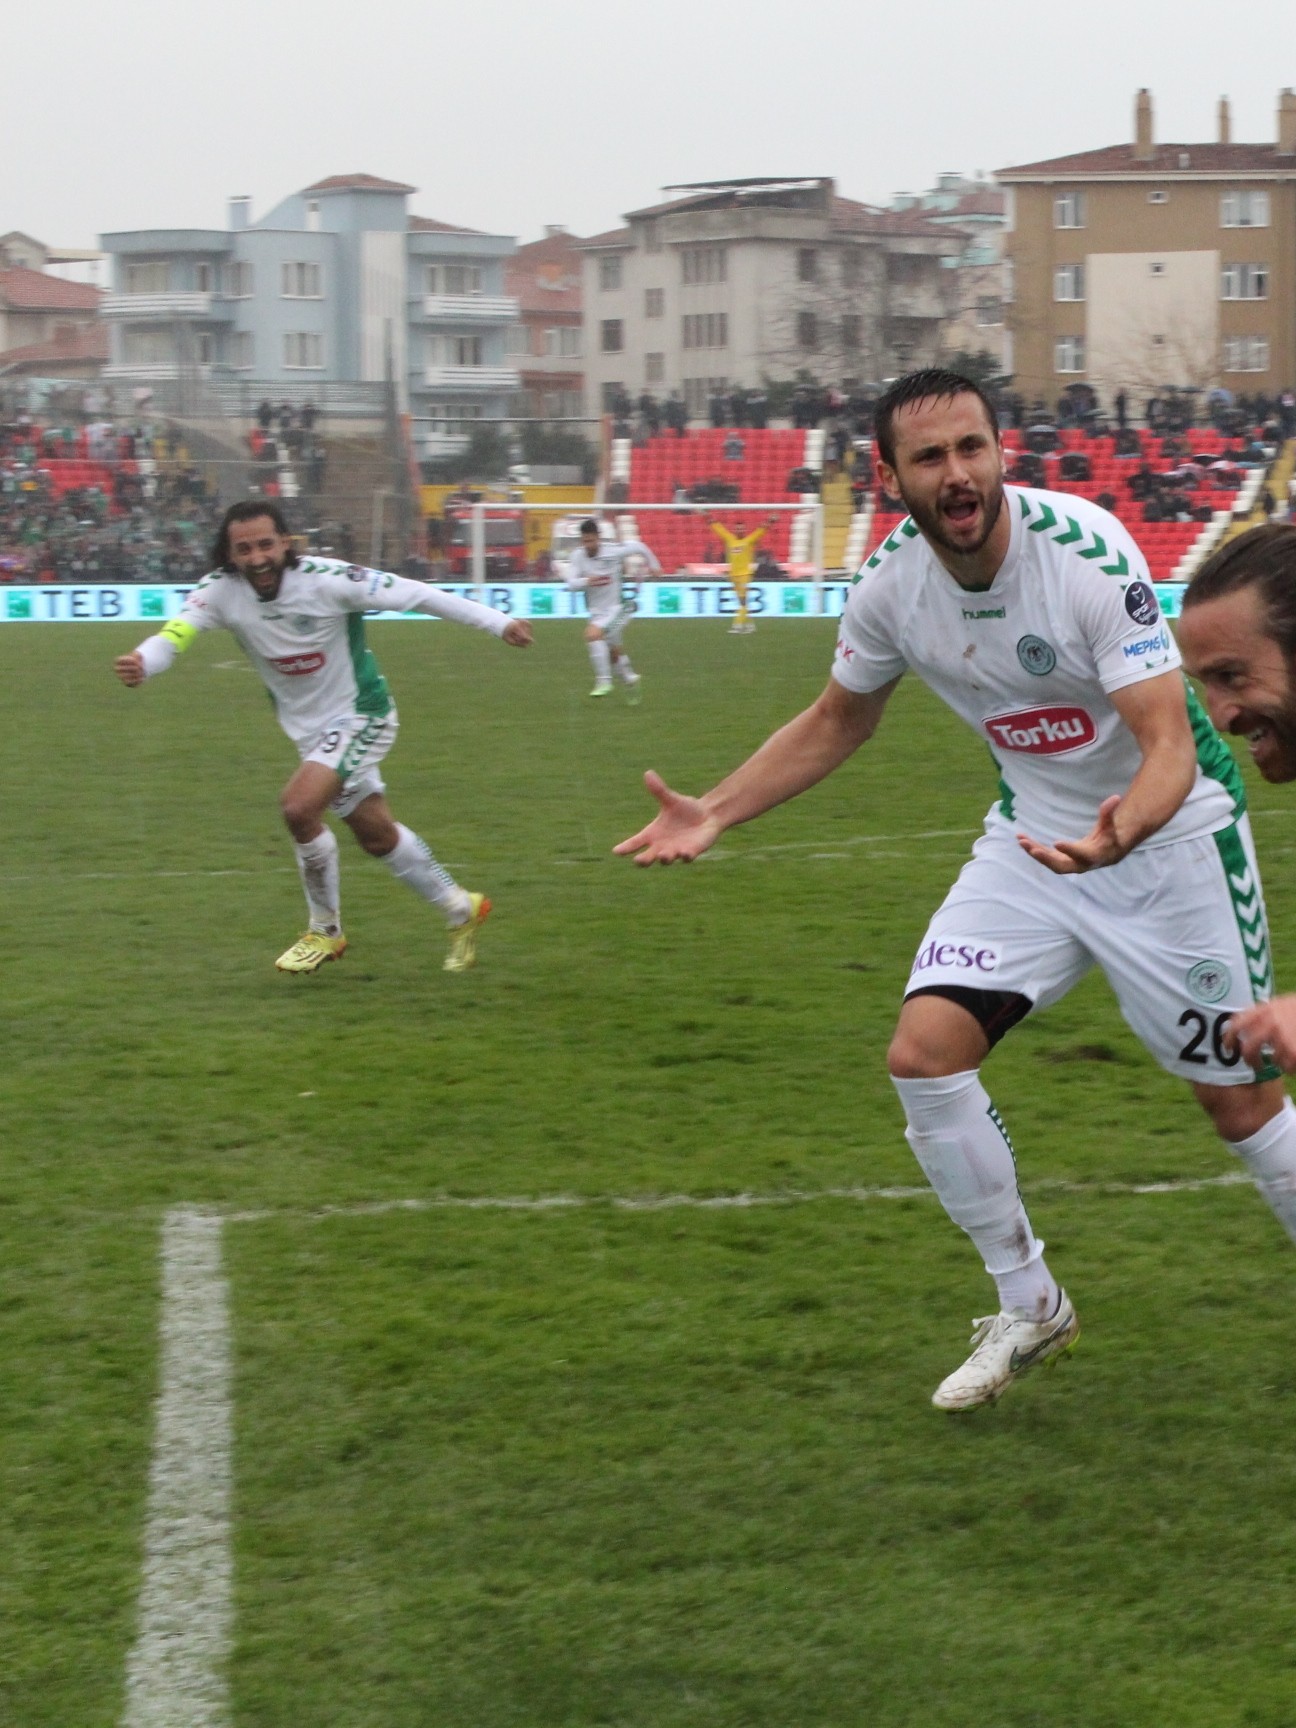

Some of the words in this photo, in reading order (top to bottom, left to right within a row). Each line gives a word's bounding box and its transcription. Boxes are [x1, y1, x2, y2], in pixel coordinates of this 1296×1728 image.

[42, 590, 123, 617] TEB
[691, 587, 764, 614] TEB
[962, 606, 1006, 620] hummel
[992, 718, 1085, 747] Torku
